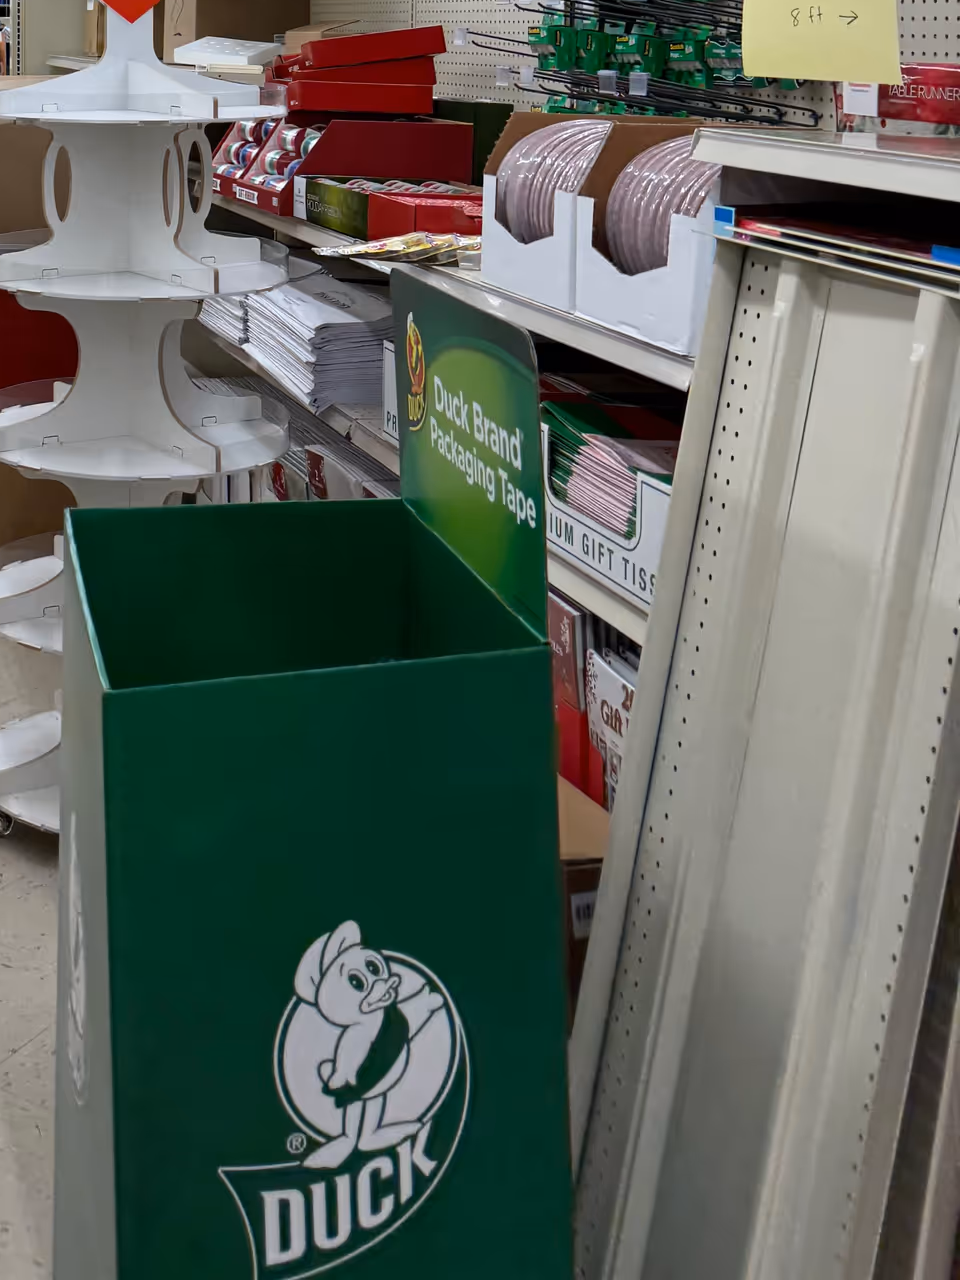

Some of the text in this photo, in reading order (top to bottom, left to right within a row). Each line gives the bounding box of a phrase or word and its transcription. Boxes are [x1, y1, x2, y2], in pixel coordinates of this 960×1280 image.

[790, 6, 823, 27] 8 ft
[407, 393, 425, 421] DUCK
[433, 375, 522, 470] Duck Brand
[430, 416, 537, 529] Packaging Tape
[582, 535, 614, 571] GIFT
[600, 699, 623, 738] Gift
[260, 1117, 438, 1267] DUCK
